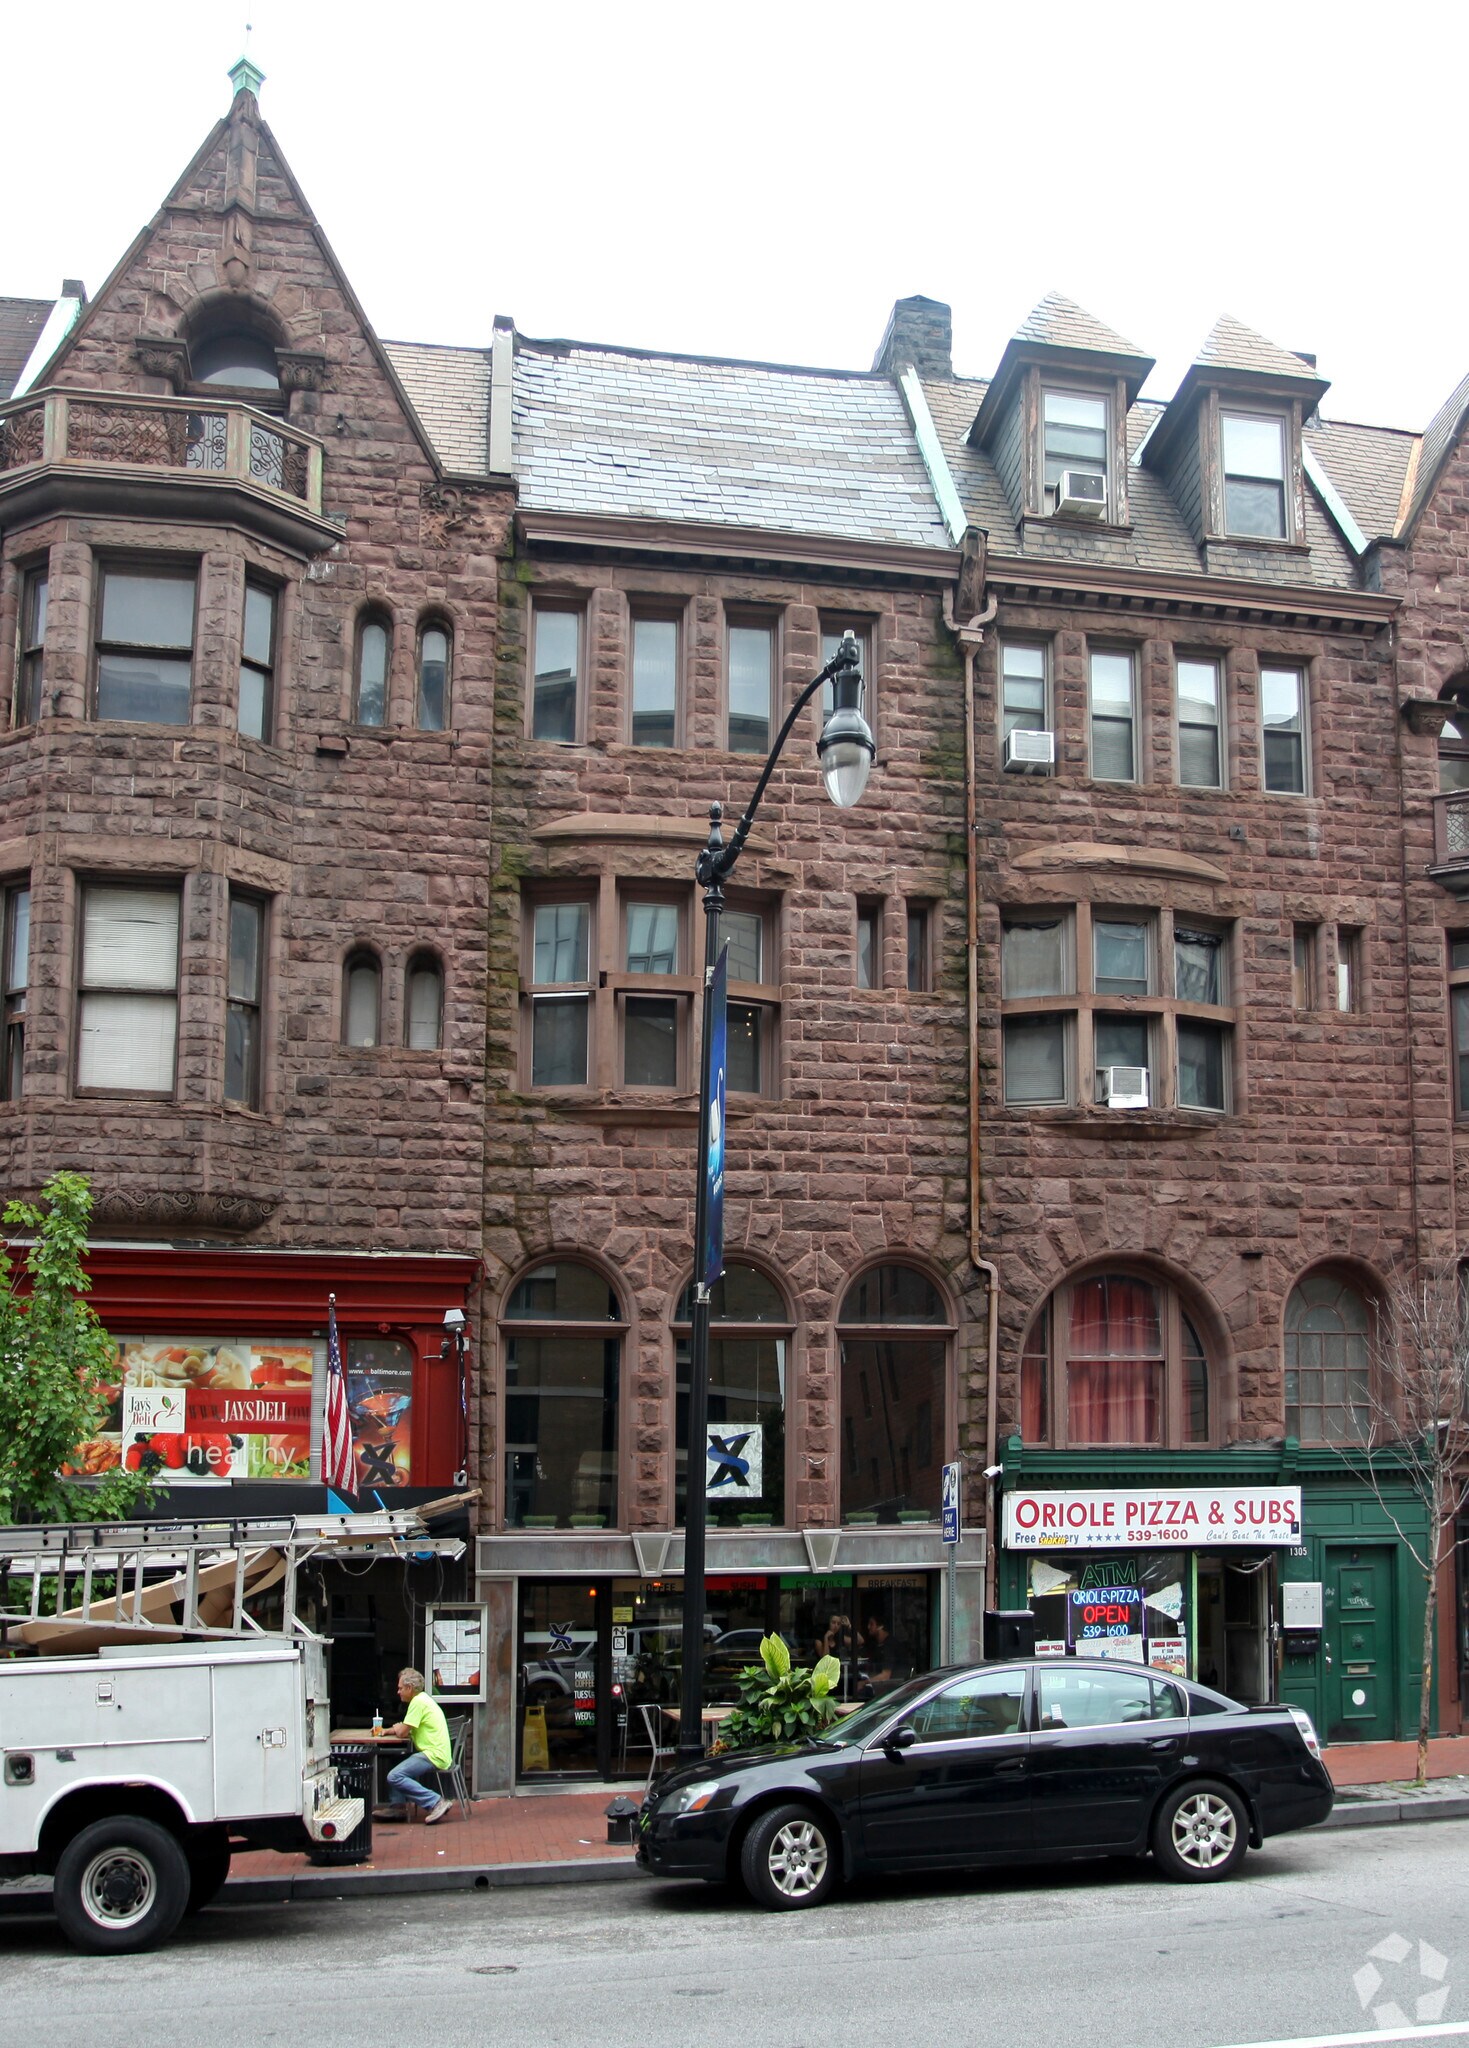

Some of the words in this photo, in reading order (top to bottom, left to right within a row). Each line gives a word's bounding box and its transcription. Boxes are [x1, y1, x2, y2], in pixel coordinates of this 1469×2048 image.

[128, 1396, 151, 1415] Jay's
[133, 1411, 151, 1426] Deli
[187, 1436, 296, 1473] healthy
[944, 1512, 954, 1524] PAY
[1016, 1499, 1115, 1528] ORIOLE
[1125, 1501, 1199, 1526] PIZZA
[1208, 1500, 1225, 1525] &
[1234, 1499, 1297, 1525] SUBS
[943, 1526, 955, 1538] HERE
[1014, 1532, 1037, 1544] Free
[1127, 1529, 1189, 1542] 539-1600
[1206, 1529, 1228, 1541] Can't
[1232, 1529, 1249, 1540] Beat
[1253, 1529, 1265, 1540] The
[1289, 1546, 1308, 1556] 1305
[1080, 1559, 1137, 1590] ATM
[868, 1579, 917, 1588] BREAKFAST
[1073, 1590, 1108, 1604] ORIOLE
[1110, 1589, 1139, 1603] PIZZA
[1083, 1605, 1130, 1624] OPEN
[1083, 1624, 1129, 1638] 539-1600
